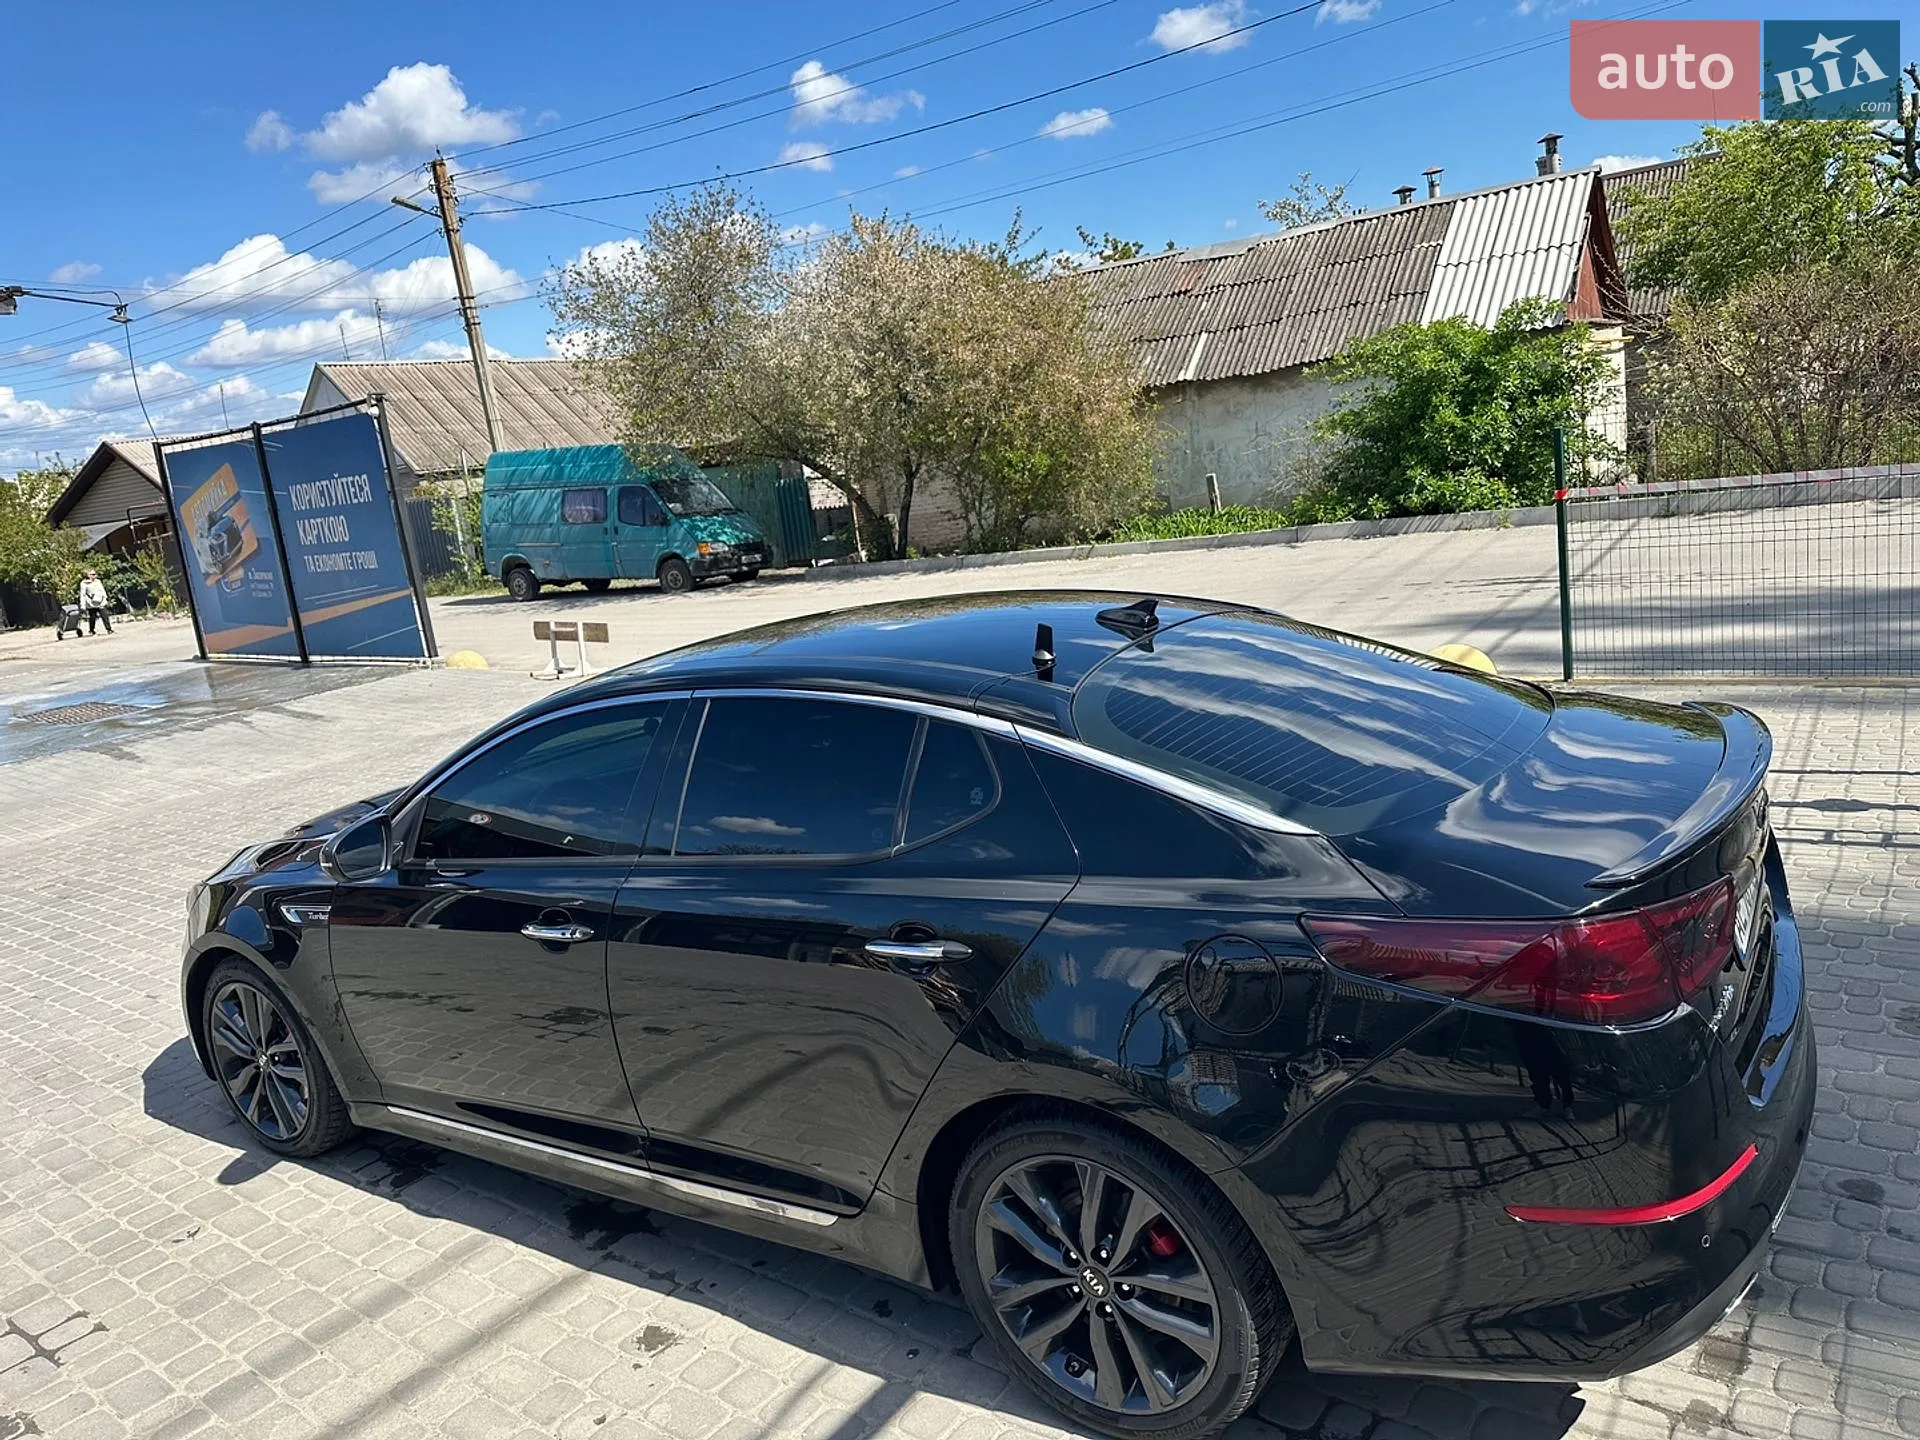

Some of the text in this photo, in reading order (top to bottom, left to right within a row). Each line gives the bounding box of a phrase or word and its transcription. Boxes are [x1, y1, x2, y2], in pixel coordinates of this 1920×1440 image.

[289, 473, 373, 511] КОРИСТУЙТЕСЯ
[296, 515, 350, 545] КАРТКОЮ
[304, 554, 316, 573] ТА
[1082, 1269, 1104, 1296] KIA
